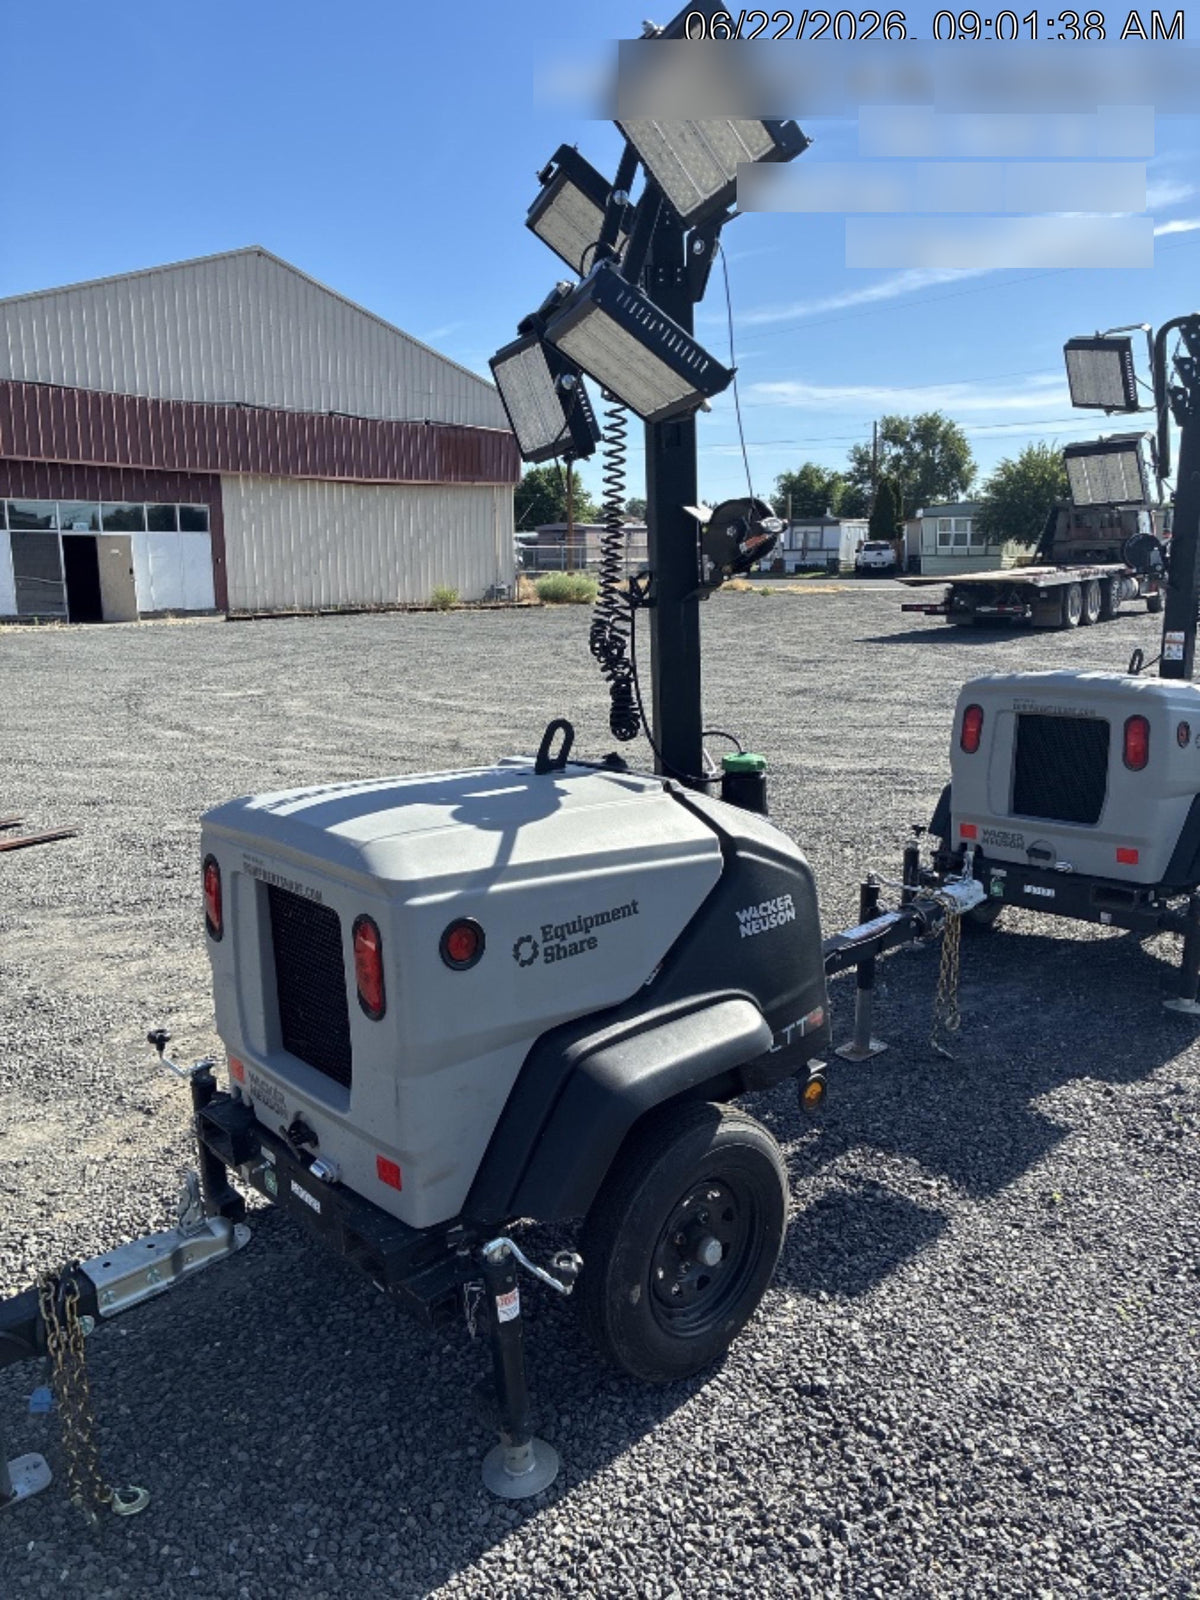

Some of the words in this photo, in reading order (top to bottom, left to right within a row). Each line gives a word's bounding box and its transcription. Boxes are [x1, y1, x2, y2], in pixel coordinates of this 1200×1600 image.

[540, 899, 639, 943] Equipment
[735, 893, 794, 923] WACKER
[739, 906, 796, 938] NEUSON
[543, 936, 599, 964] Share
